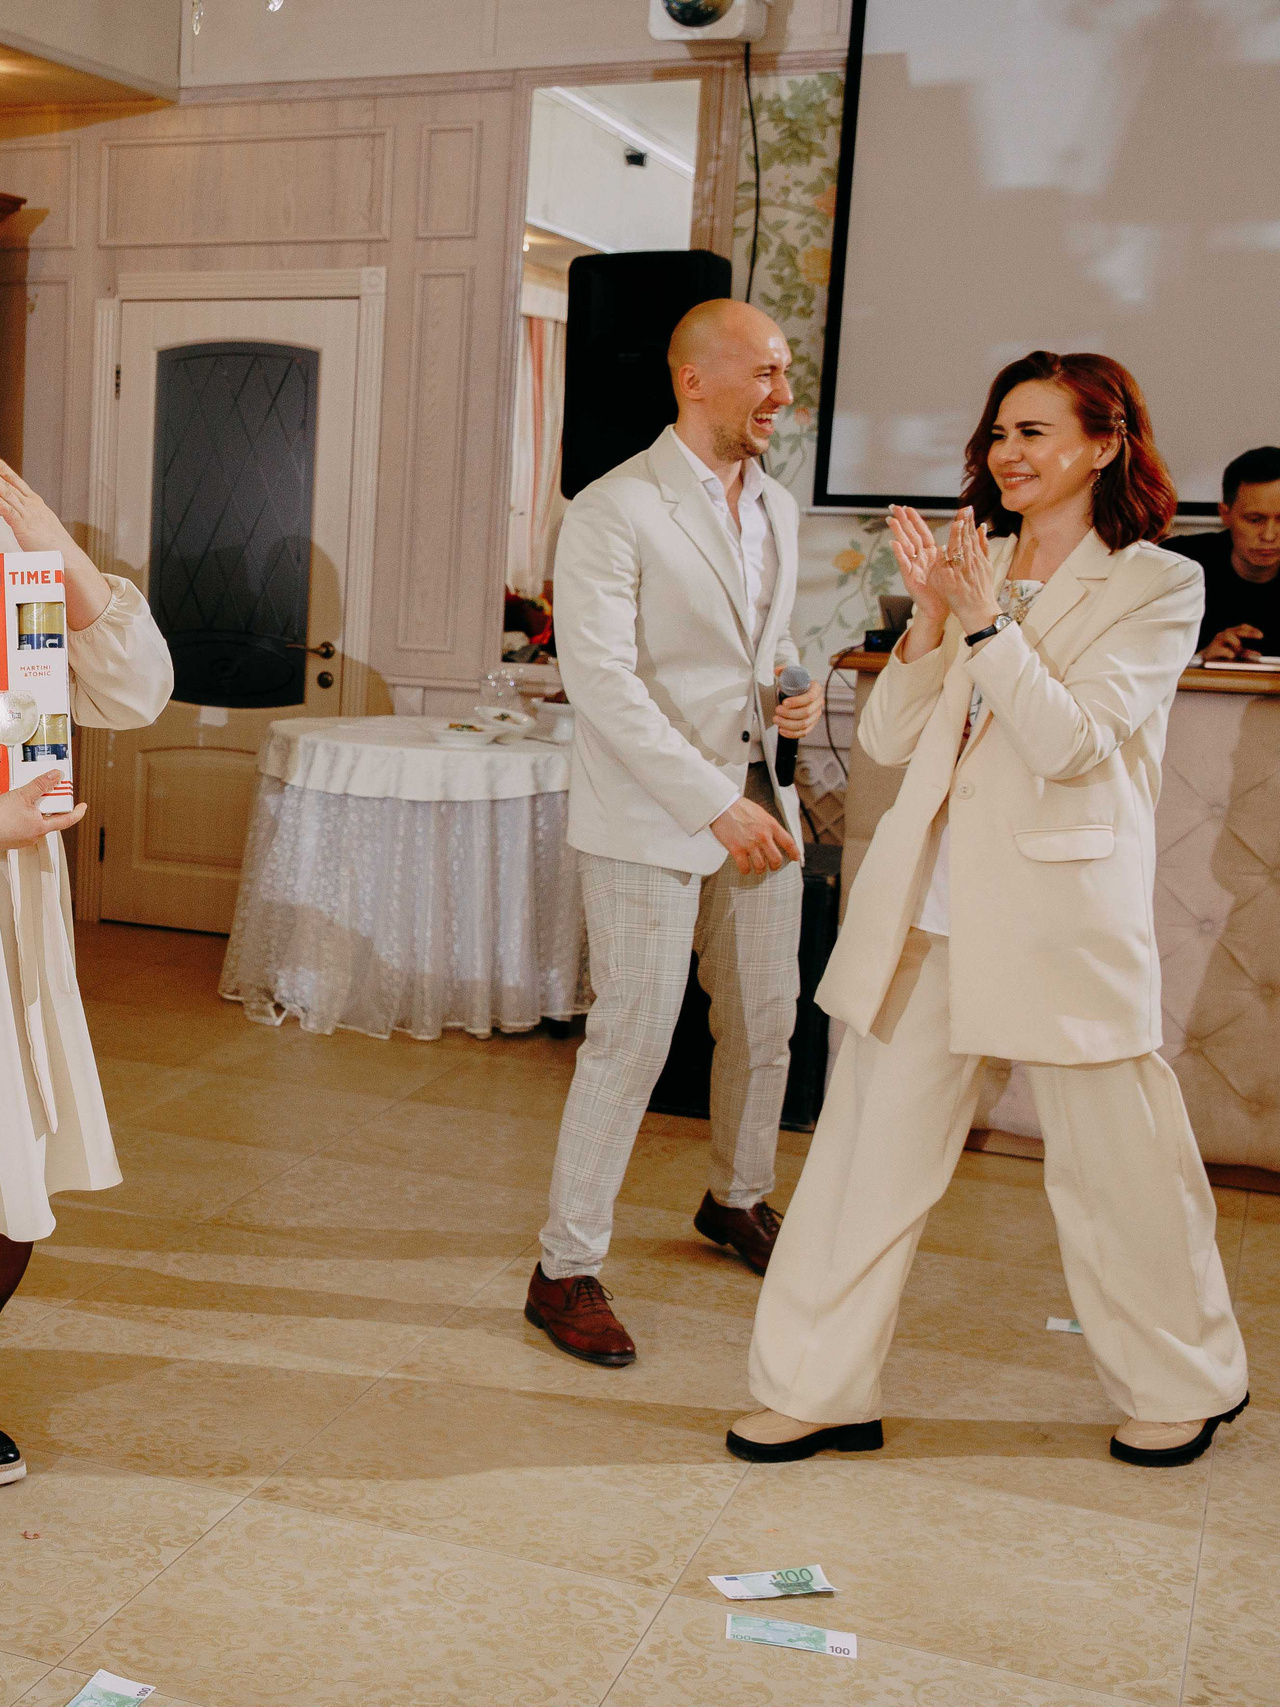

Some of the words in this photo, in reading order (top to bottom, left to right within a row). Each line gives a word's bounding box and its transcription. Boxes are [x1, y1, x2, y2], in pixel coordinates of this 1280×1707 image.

[9, 570, 50, 585] TIME
[776, 1567, 814, 1584] 100
[731, 1633, 751, 1641] 100
[829, 1645, 850, 1656] 100
